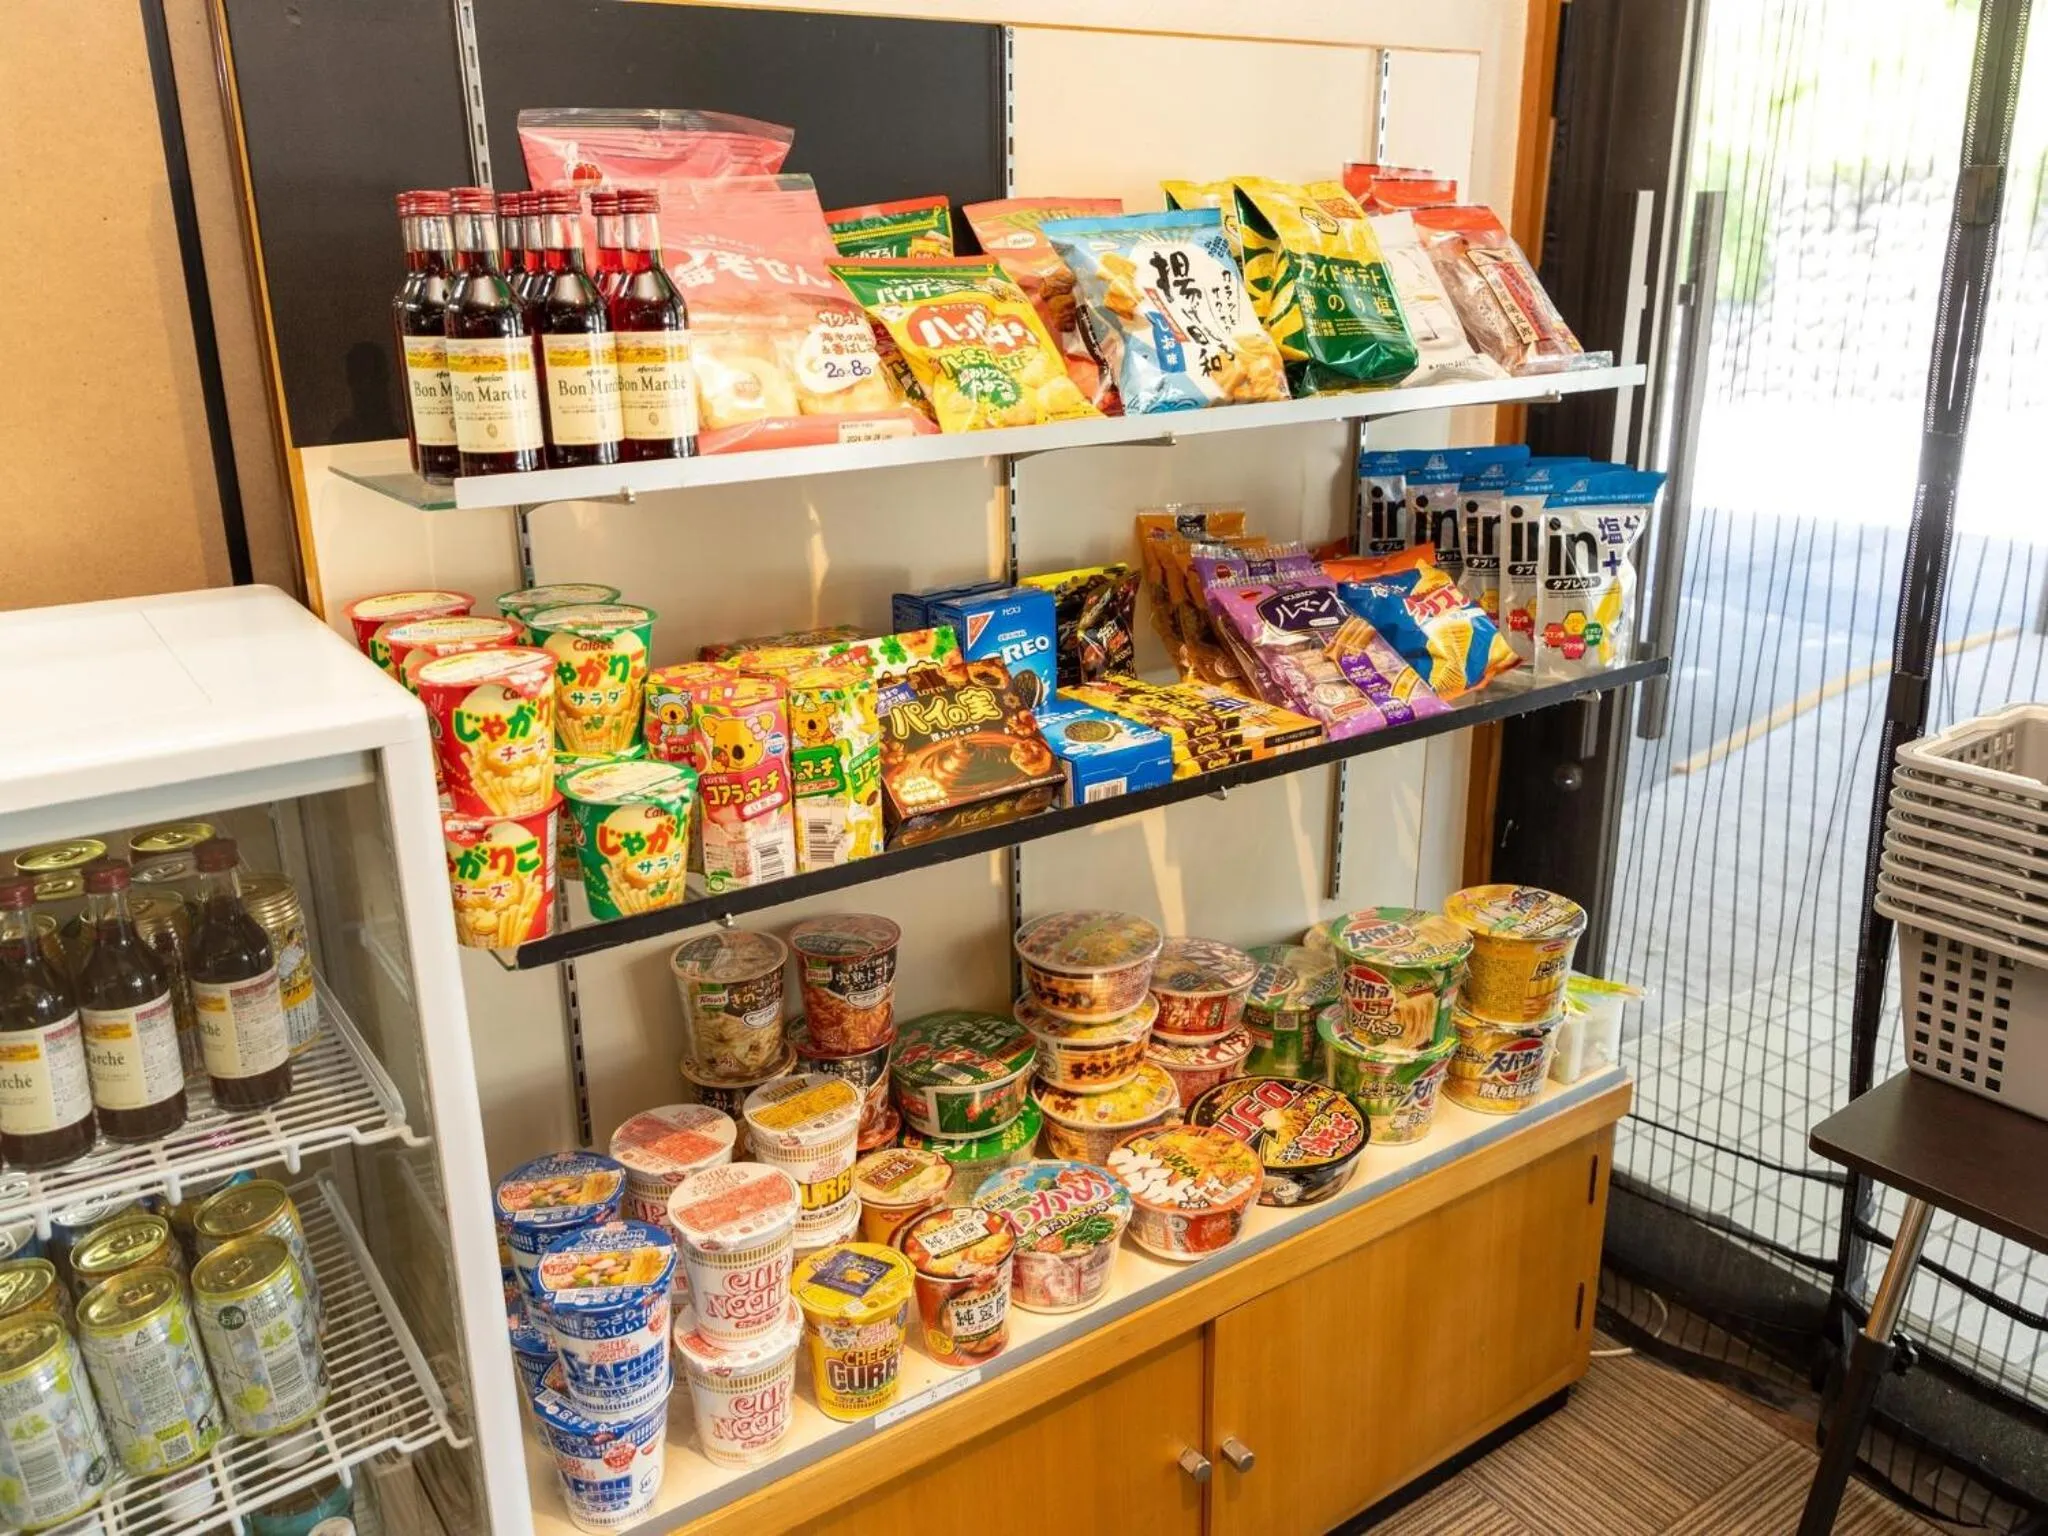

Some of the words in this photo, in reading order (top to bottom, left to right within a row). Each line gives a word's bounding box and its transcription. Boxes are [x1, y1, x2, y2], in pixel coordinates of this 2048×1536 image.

[557, 379, 588, 397] Bon
[1549, 517, 1599, 577] in
[570, 688, 624, 706] サラダ
[890, 688, 1003, 738] パイの実
[501, 737, 547, 763] チーズ
[705, 769, 780, 806] コアラのマーチ
[453, 882, 510, 900] チーズ
